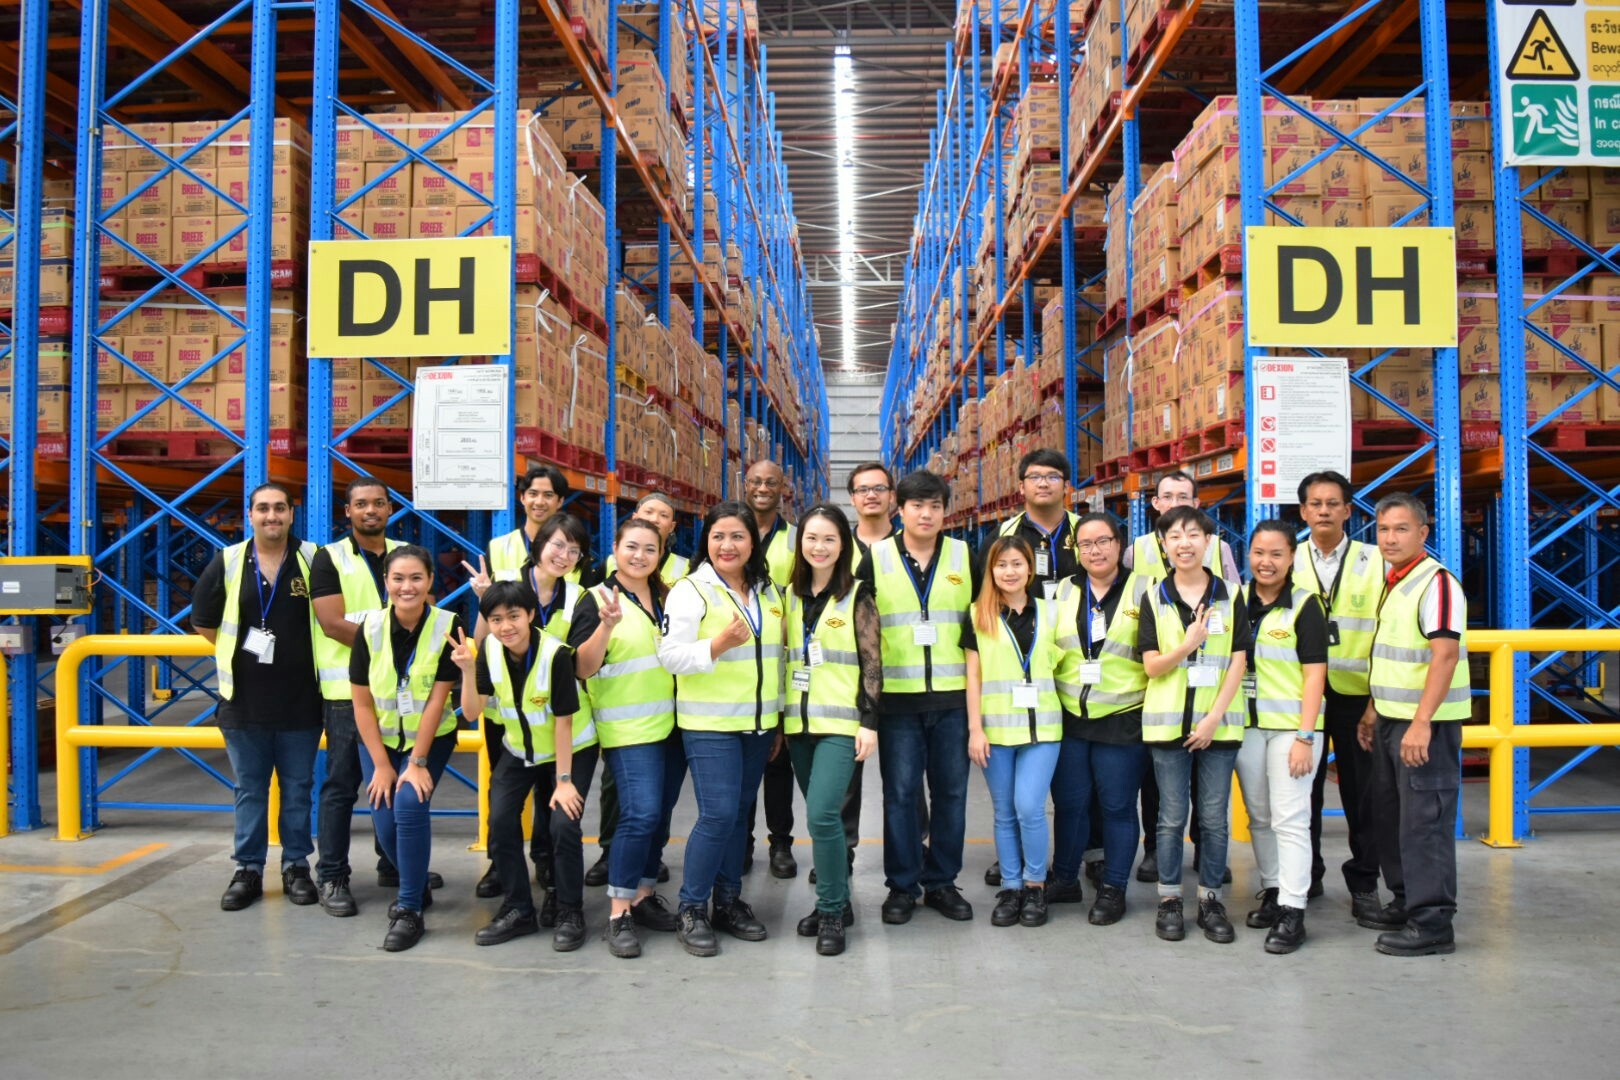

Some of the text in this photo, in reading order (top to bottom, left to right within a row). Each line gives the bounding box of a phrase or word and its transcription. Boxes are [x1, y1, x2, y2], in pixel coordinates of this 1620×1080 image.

[1594, 116, 1606, 129] In
[423, 177, 445, 188] BREEZE
[374, 222, 396, 234] BREEZE
[420, 222, 444, 233] BREEZE
[136, 233, 158, 244] BREEZE
[182, 232, 204, 242] BREEZE
[1278, 245, 1420, 325] DH
[338, 257, 475, 336] DH
[132, 350, 154, 362] BREEZE
[178, 350, 200, 360] BREEZE
